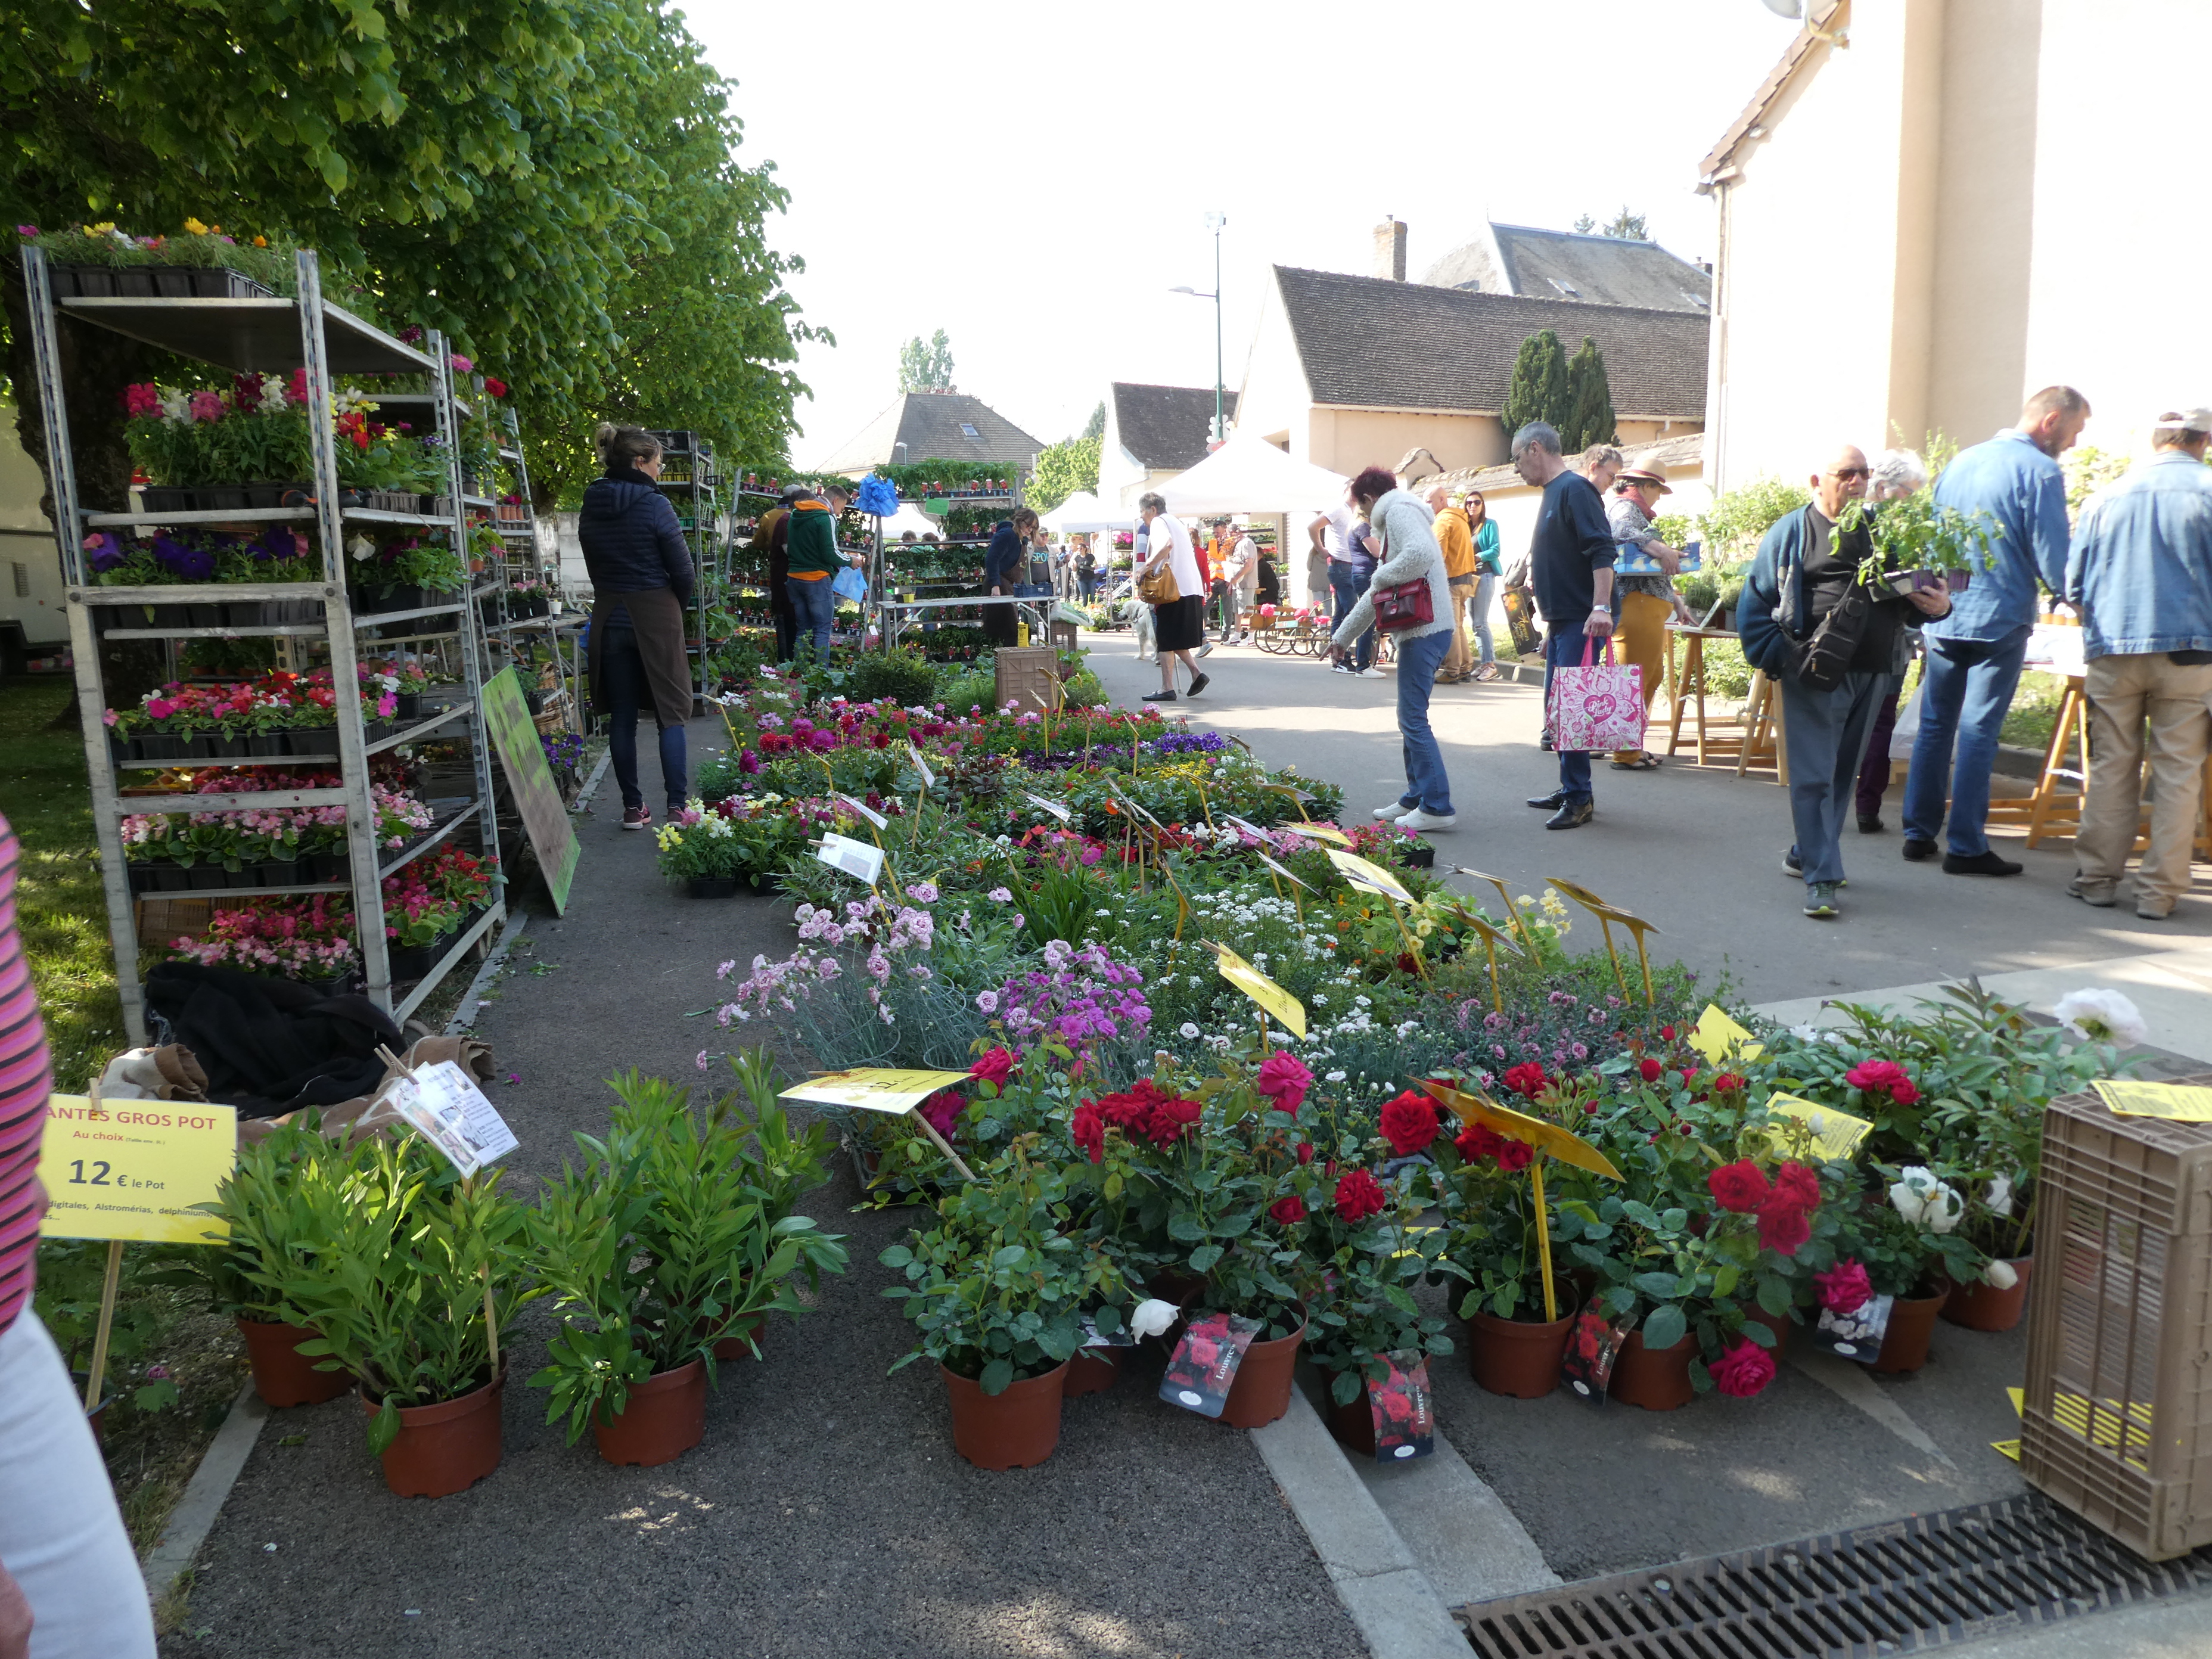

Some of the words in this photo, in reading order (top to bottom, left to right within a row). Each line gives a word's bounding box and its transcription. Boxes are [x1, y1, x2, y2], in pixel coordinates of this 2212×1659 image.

[1585, 697, 1609, 713] Pink
[1592, 705, 1614, 717] Lady
[46, 1106, 110, 1121] ANTES
[117, 1112, 172, 1126] GROS
[178, 1116, 216, 1130] POT
[73, 1130, 89, 1139] Au
[93, 1132, 123, 1141] choix
[69, 1160, 111, 1185] 12
[117, 1175, 128, 1186] €
[132, 1179, 142, 1188] le
[145, 1180, 164, 1189] Pot
[95, 1203, 153, 1214] Alstromérias,
